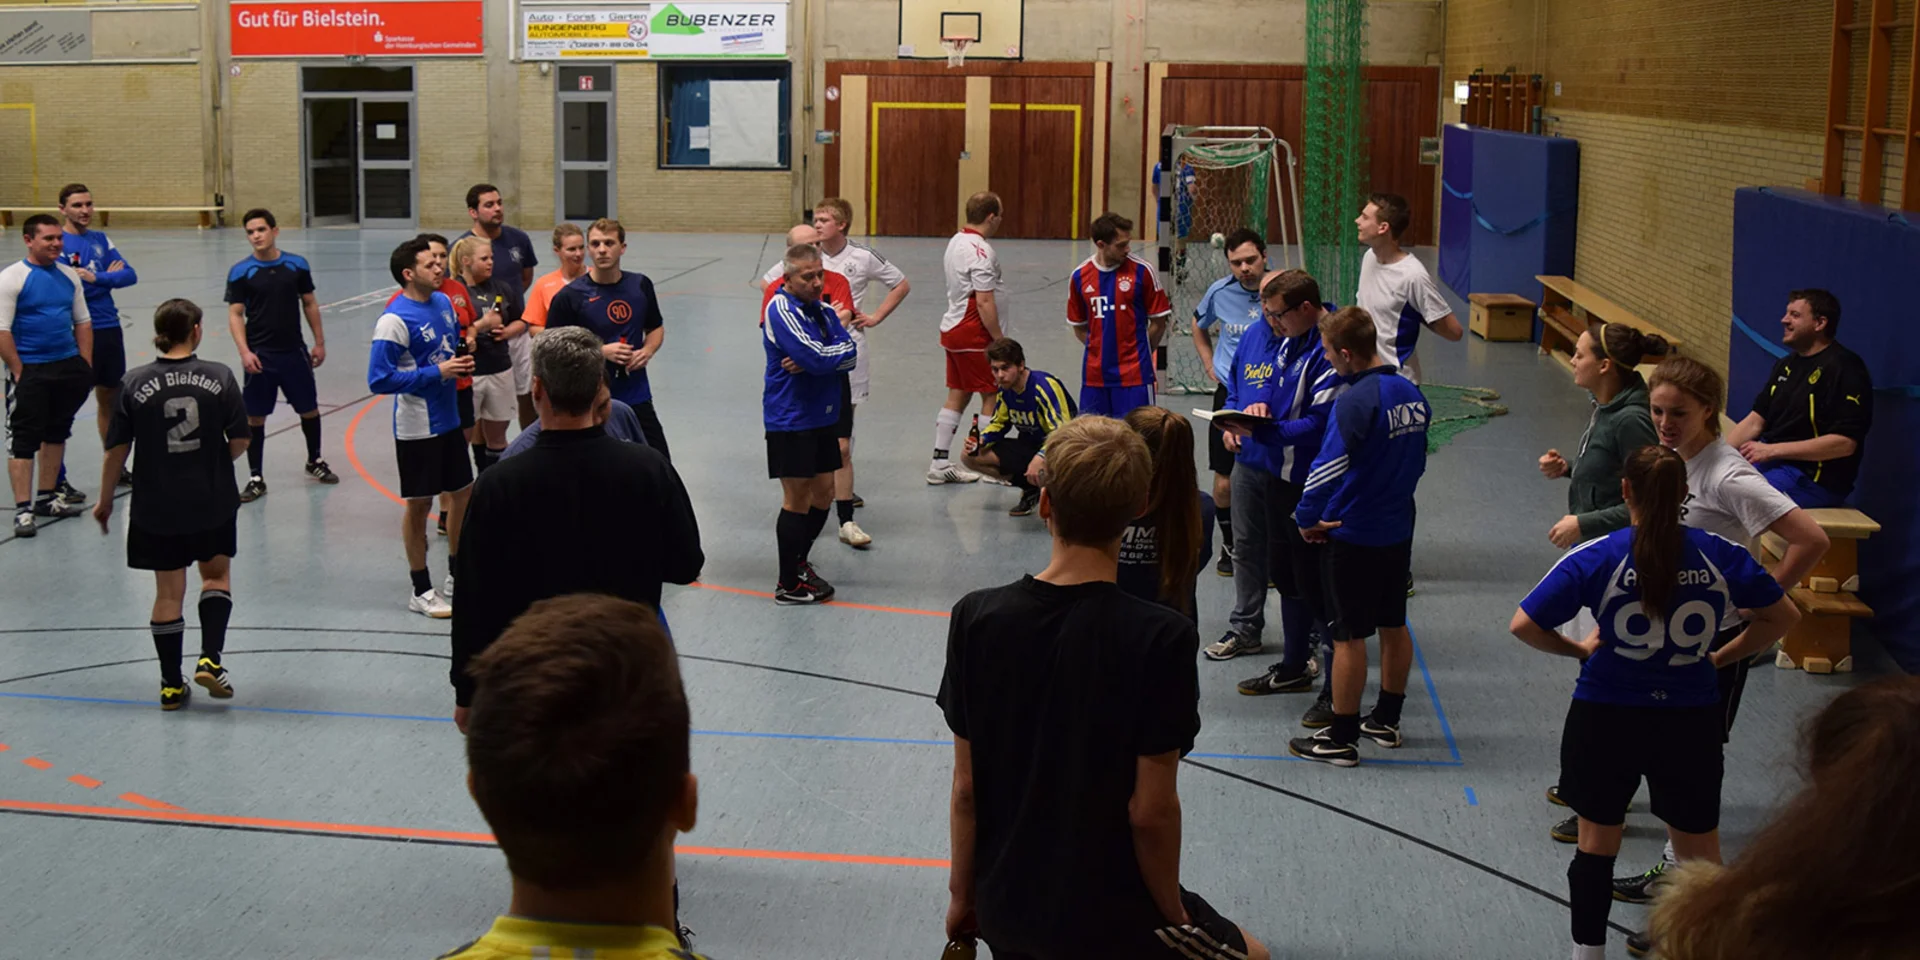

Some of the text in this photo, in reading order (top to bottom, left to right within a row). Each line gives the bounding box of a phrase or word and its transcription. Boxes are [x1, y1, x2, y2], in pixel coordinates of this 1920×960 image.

[238, 9, 385, 27] Gut für Bielstein.
[528, 12, 647, 21] Auto Forst Garten
[666, 14, 775, 26] BUBENZER
[528, 23, 607, 31] HUNGENBERG
[611, 304, 628, 320] 90
[422, 327, 437, 342] SW
[133, 371, 222, 404] BSV Bielstein
[163, 396, 201, 453] 2
[1387, 402, 1427, 431] BOS
[1613, 600, 1716, 666] 99
